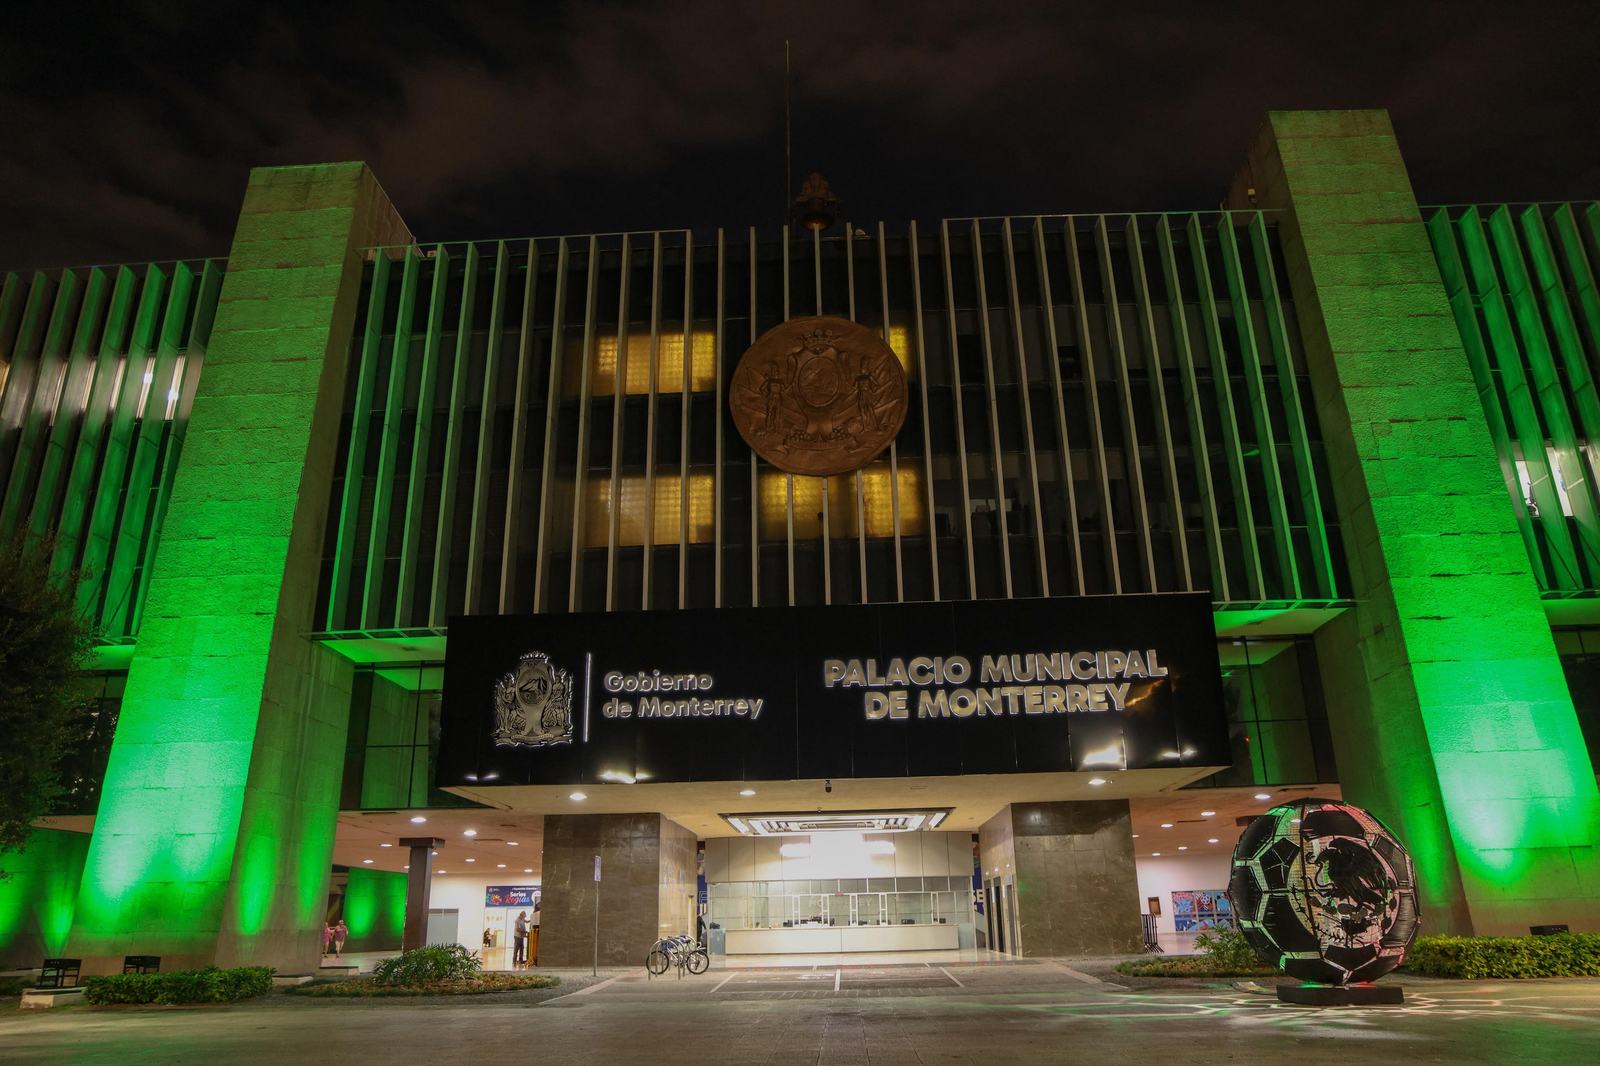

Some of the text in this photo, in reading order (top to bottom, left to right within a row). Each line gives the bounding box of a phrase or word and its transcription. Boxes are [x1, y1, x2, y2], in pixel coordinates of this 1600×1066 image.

[604, 670, 713, 691] Gobierno
[824, 649, 1168, 687] PALACIO MUNICIPAL
[602, 697, 764, 719] de Monterrey
[864, 682, 1131, 719] DE MONTERREY
